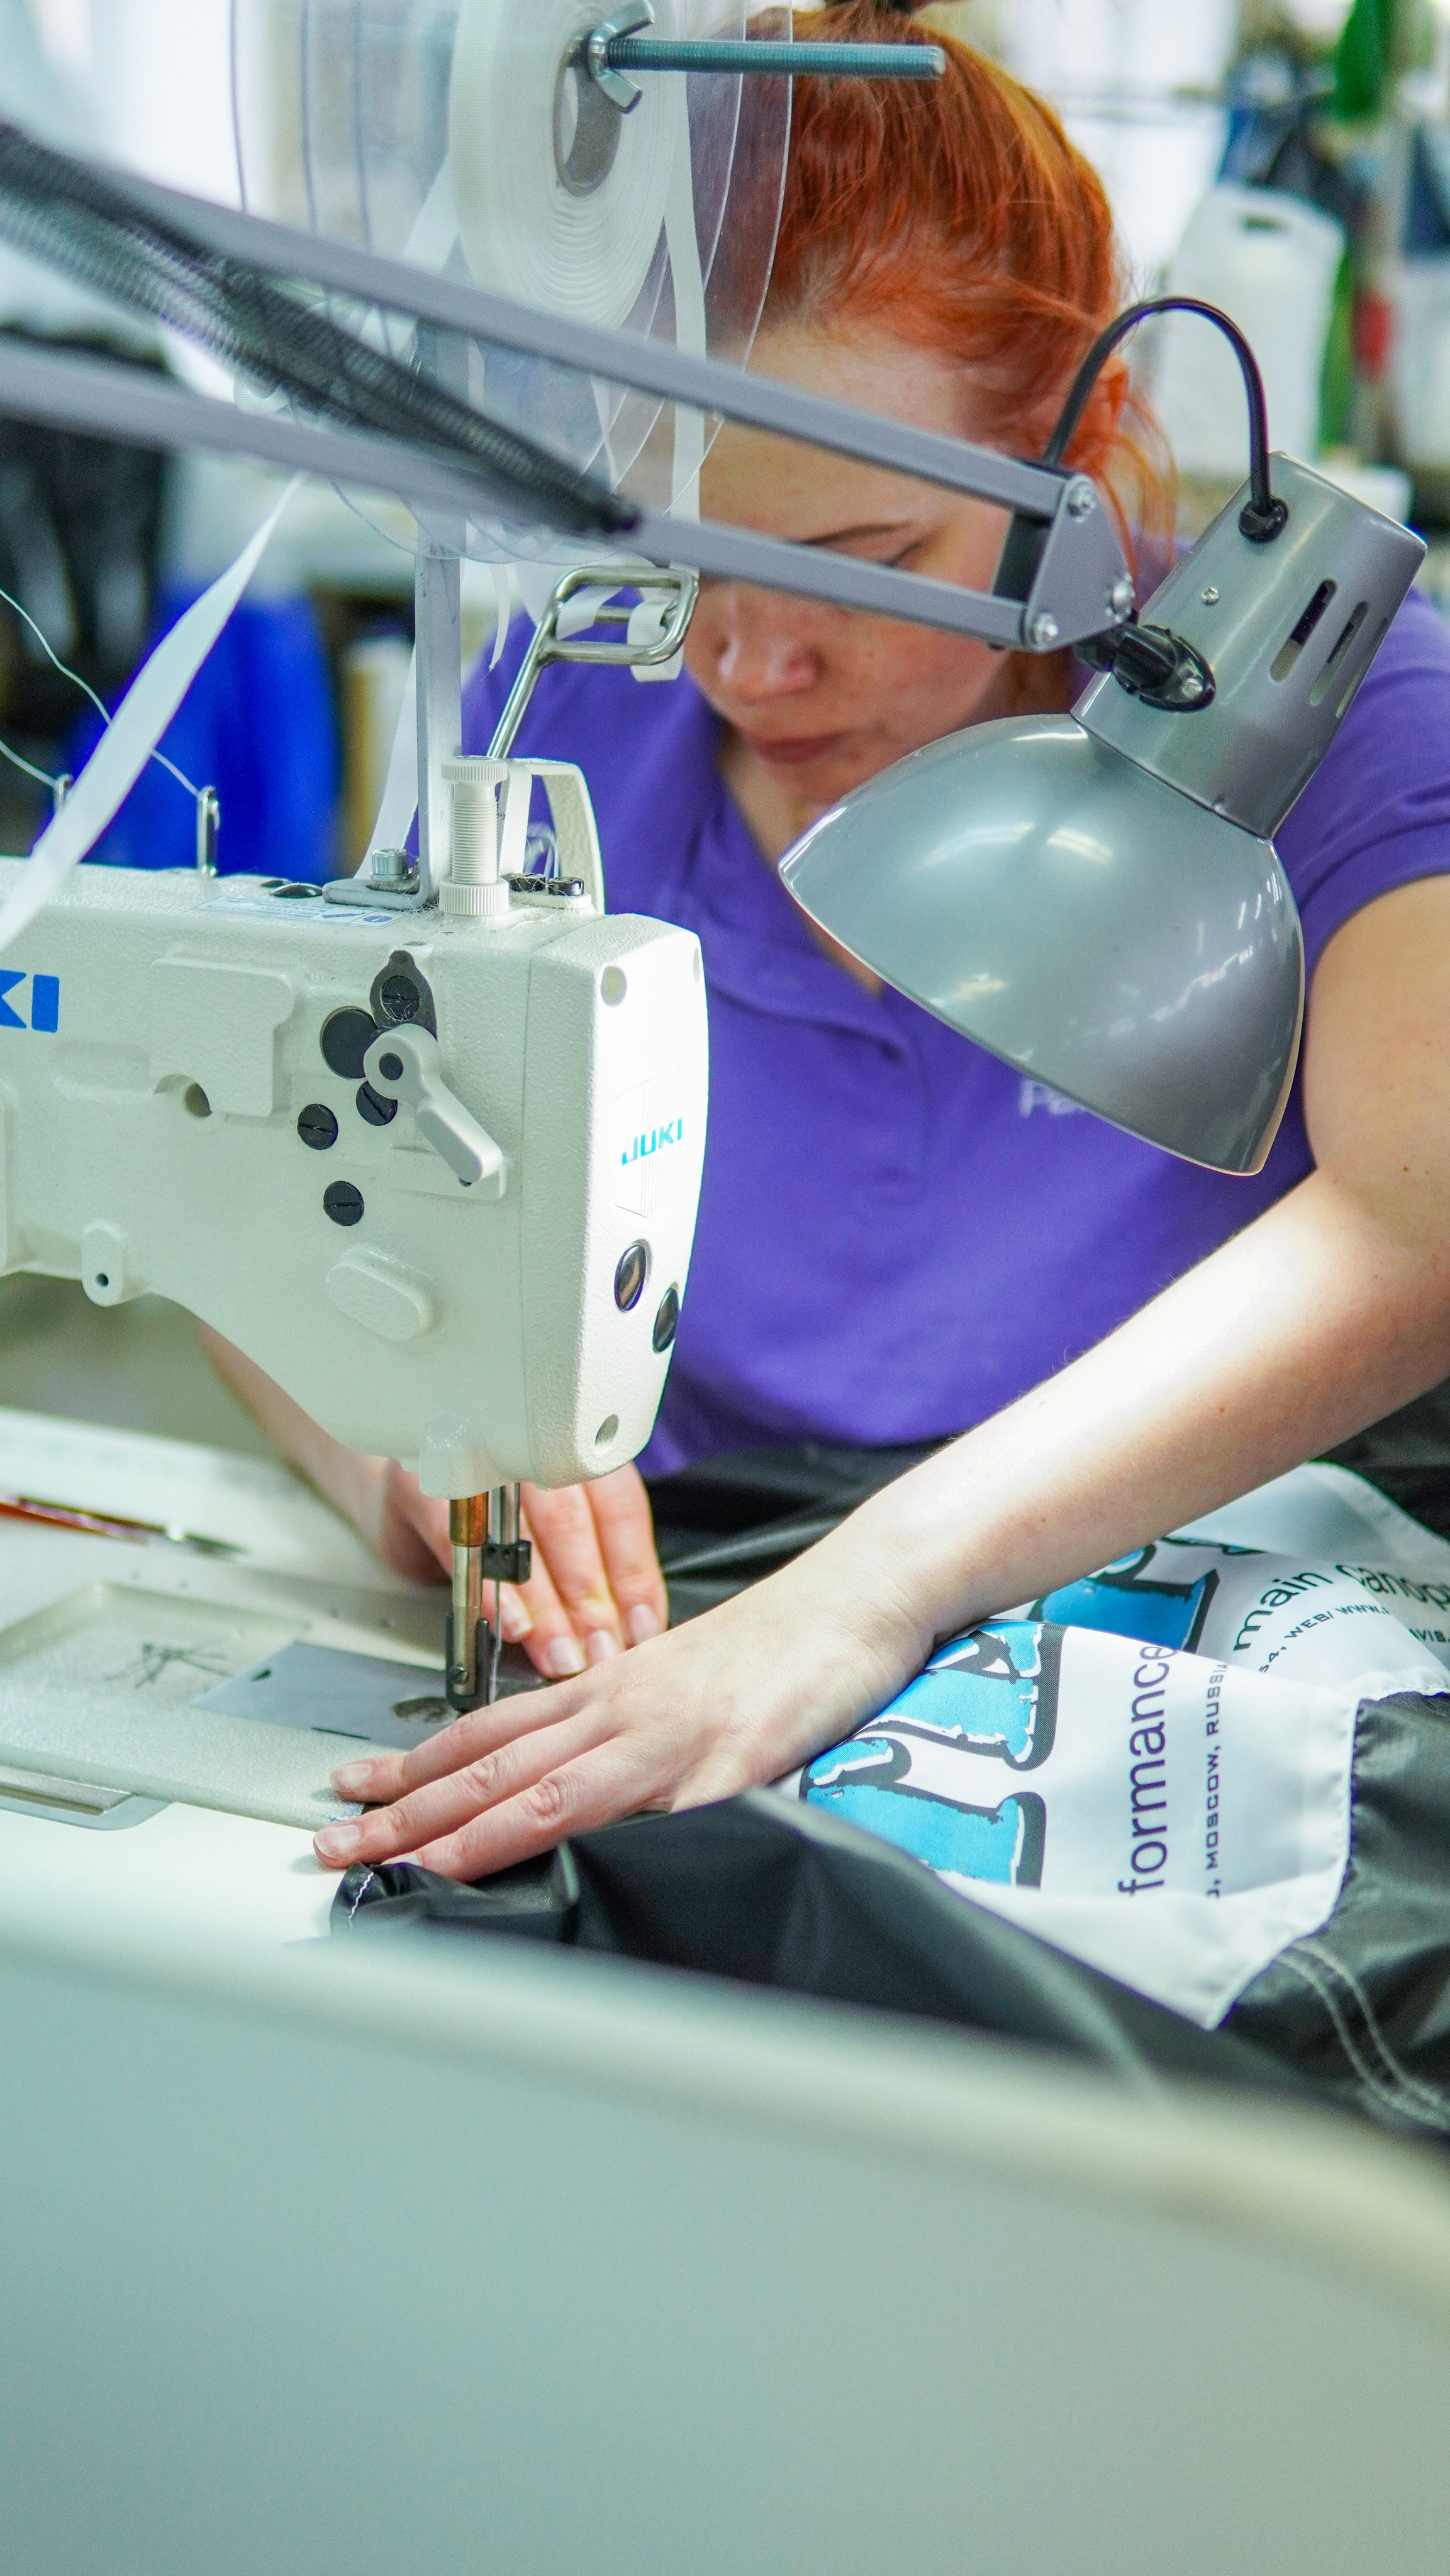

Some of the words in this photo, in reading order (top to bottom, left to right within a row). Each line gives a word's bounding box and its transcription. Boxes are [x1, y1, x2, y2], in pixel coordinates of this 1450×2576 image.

[622, 1117, 683, 1166] JUKI
[1233, 1572, 1334, 1652] main
[1118, 1646, 1179, 1896] formance
